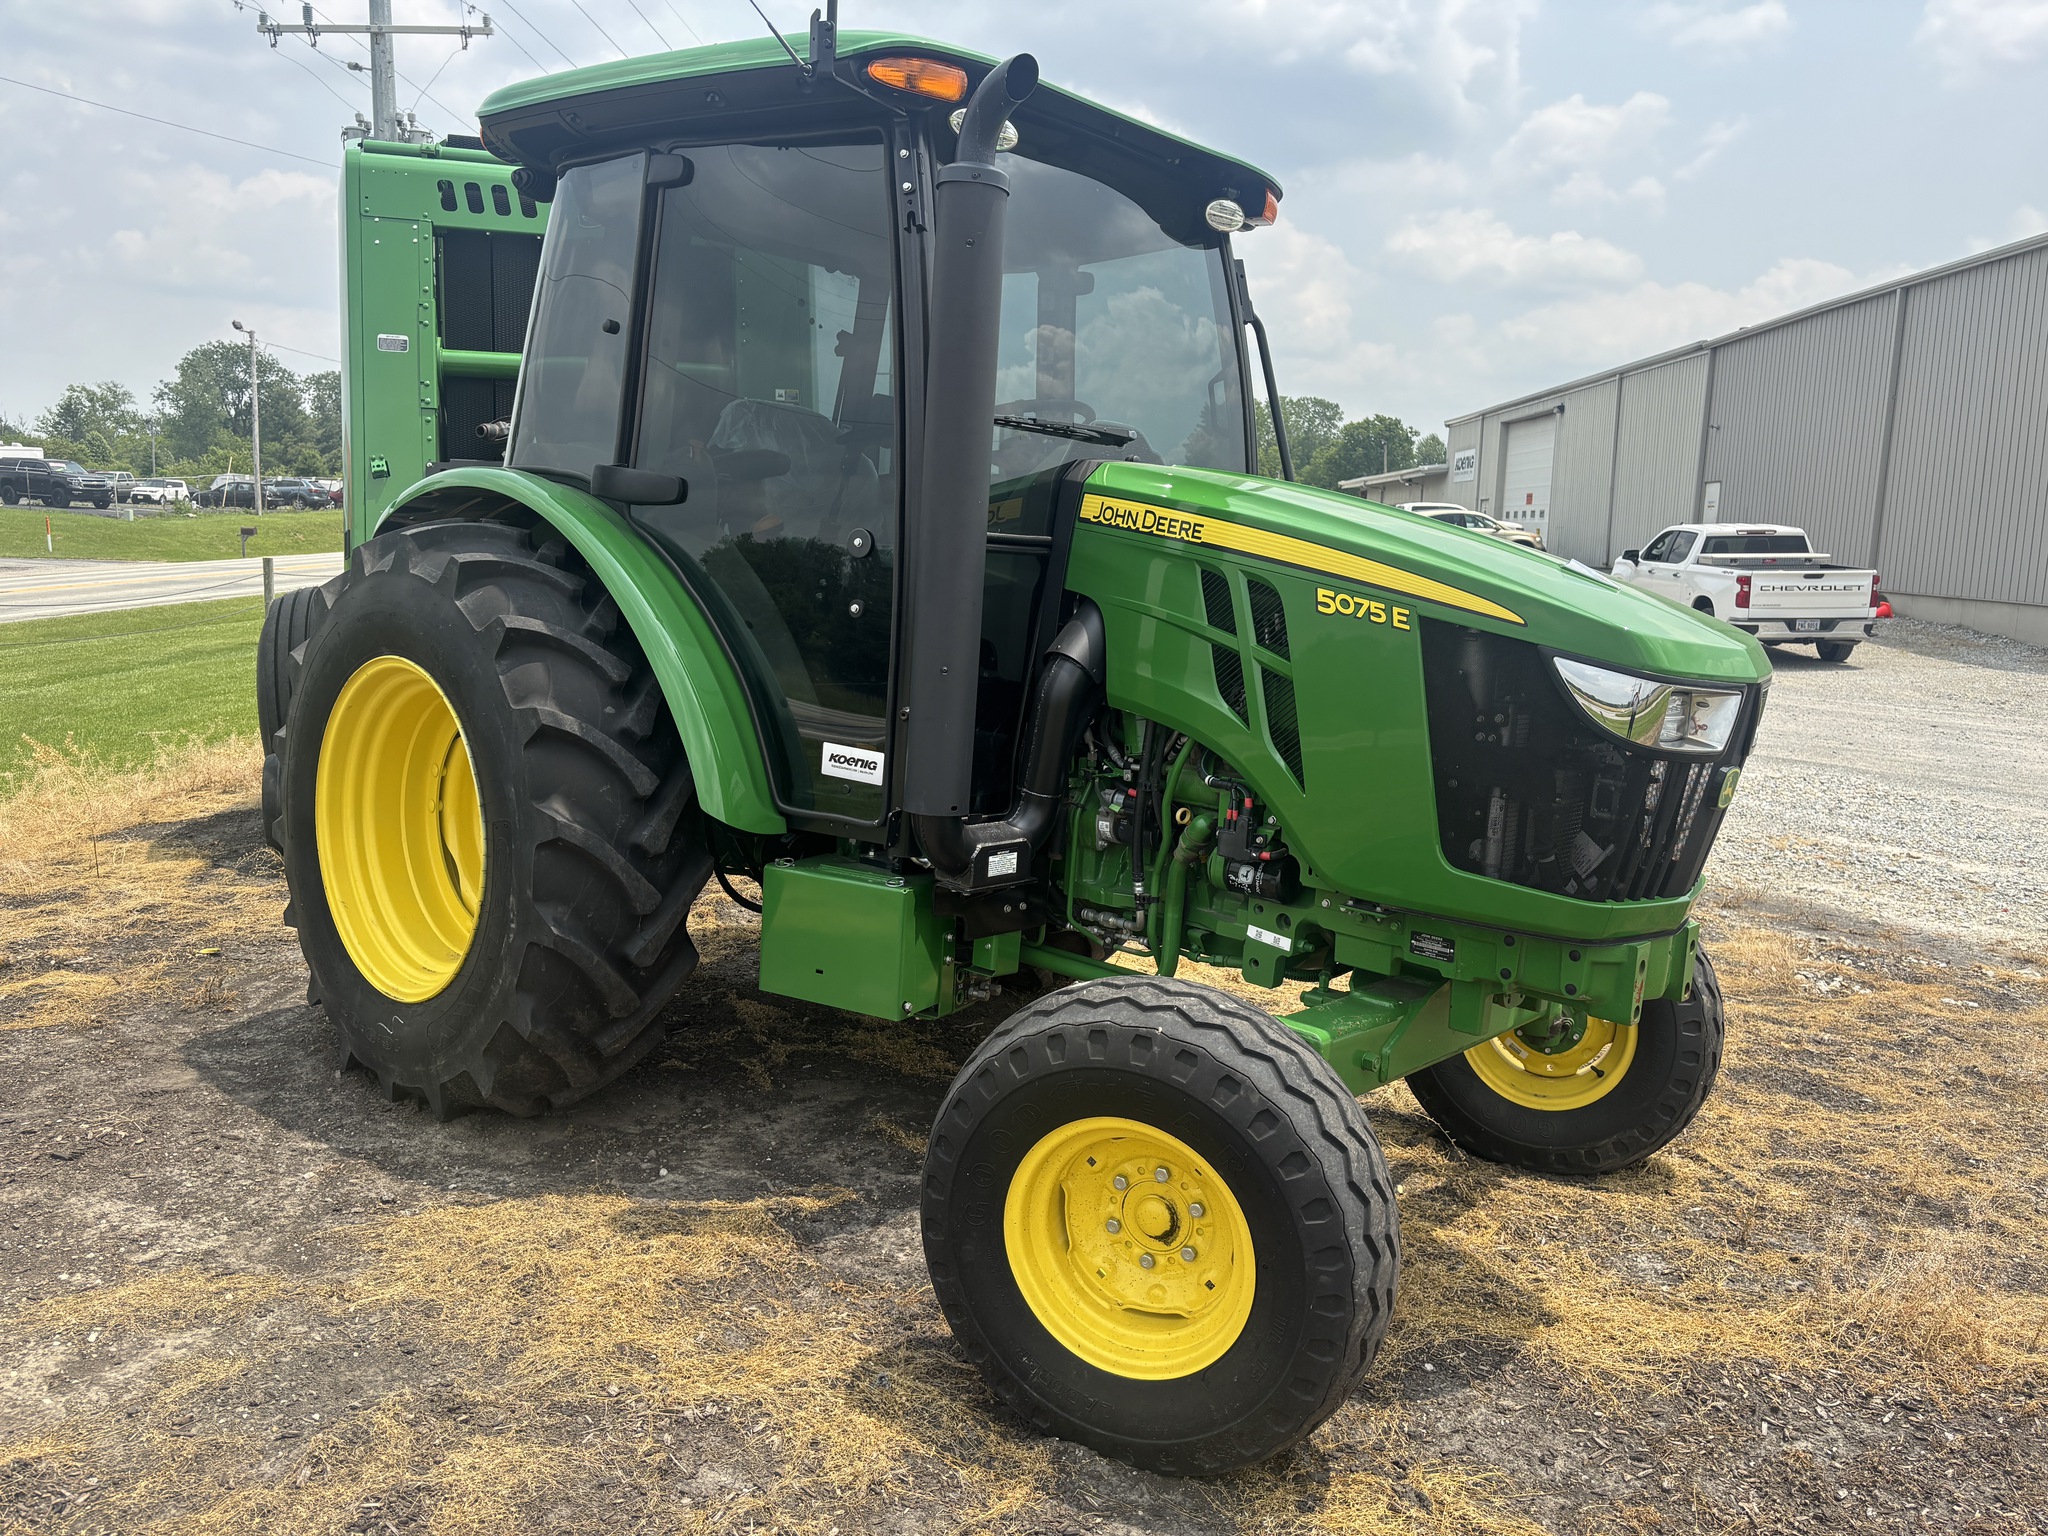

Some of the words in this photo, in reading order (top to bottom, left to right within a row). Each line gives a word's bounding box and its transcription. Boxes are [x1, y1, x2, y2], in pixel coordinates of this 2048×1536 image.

[1092, 501, 1139, 527] JOHN
[1141, 509, 1205, 540] DEERE
[1316, 587, 1387, 624] 5075
[1391, 605, 1411, 631] E
